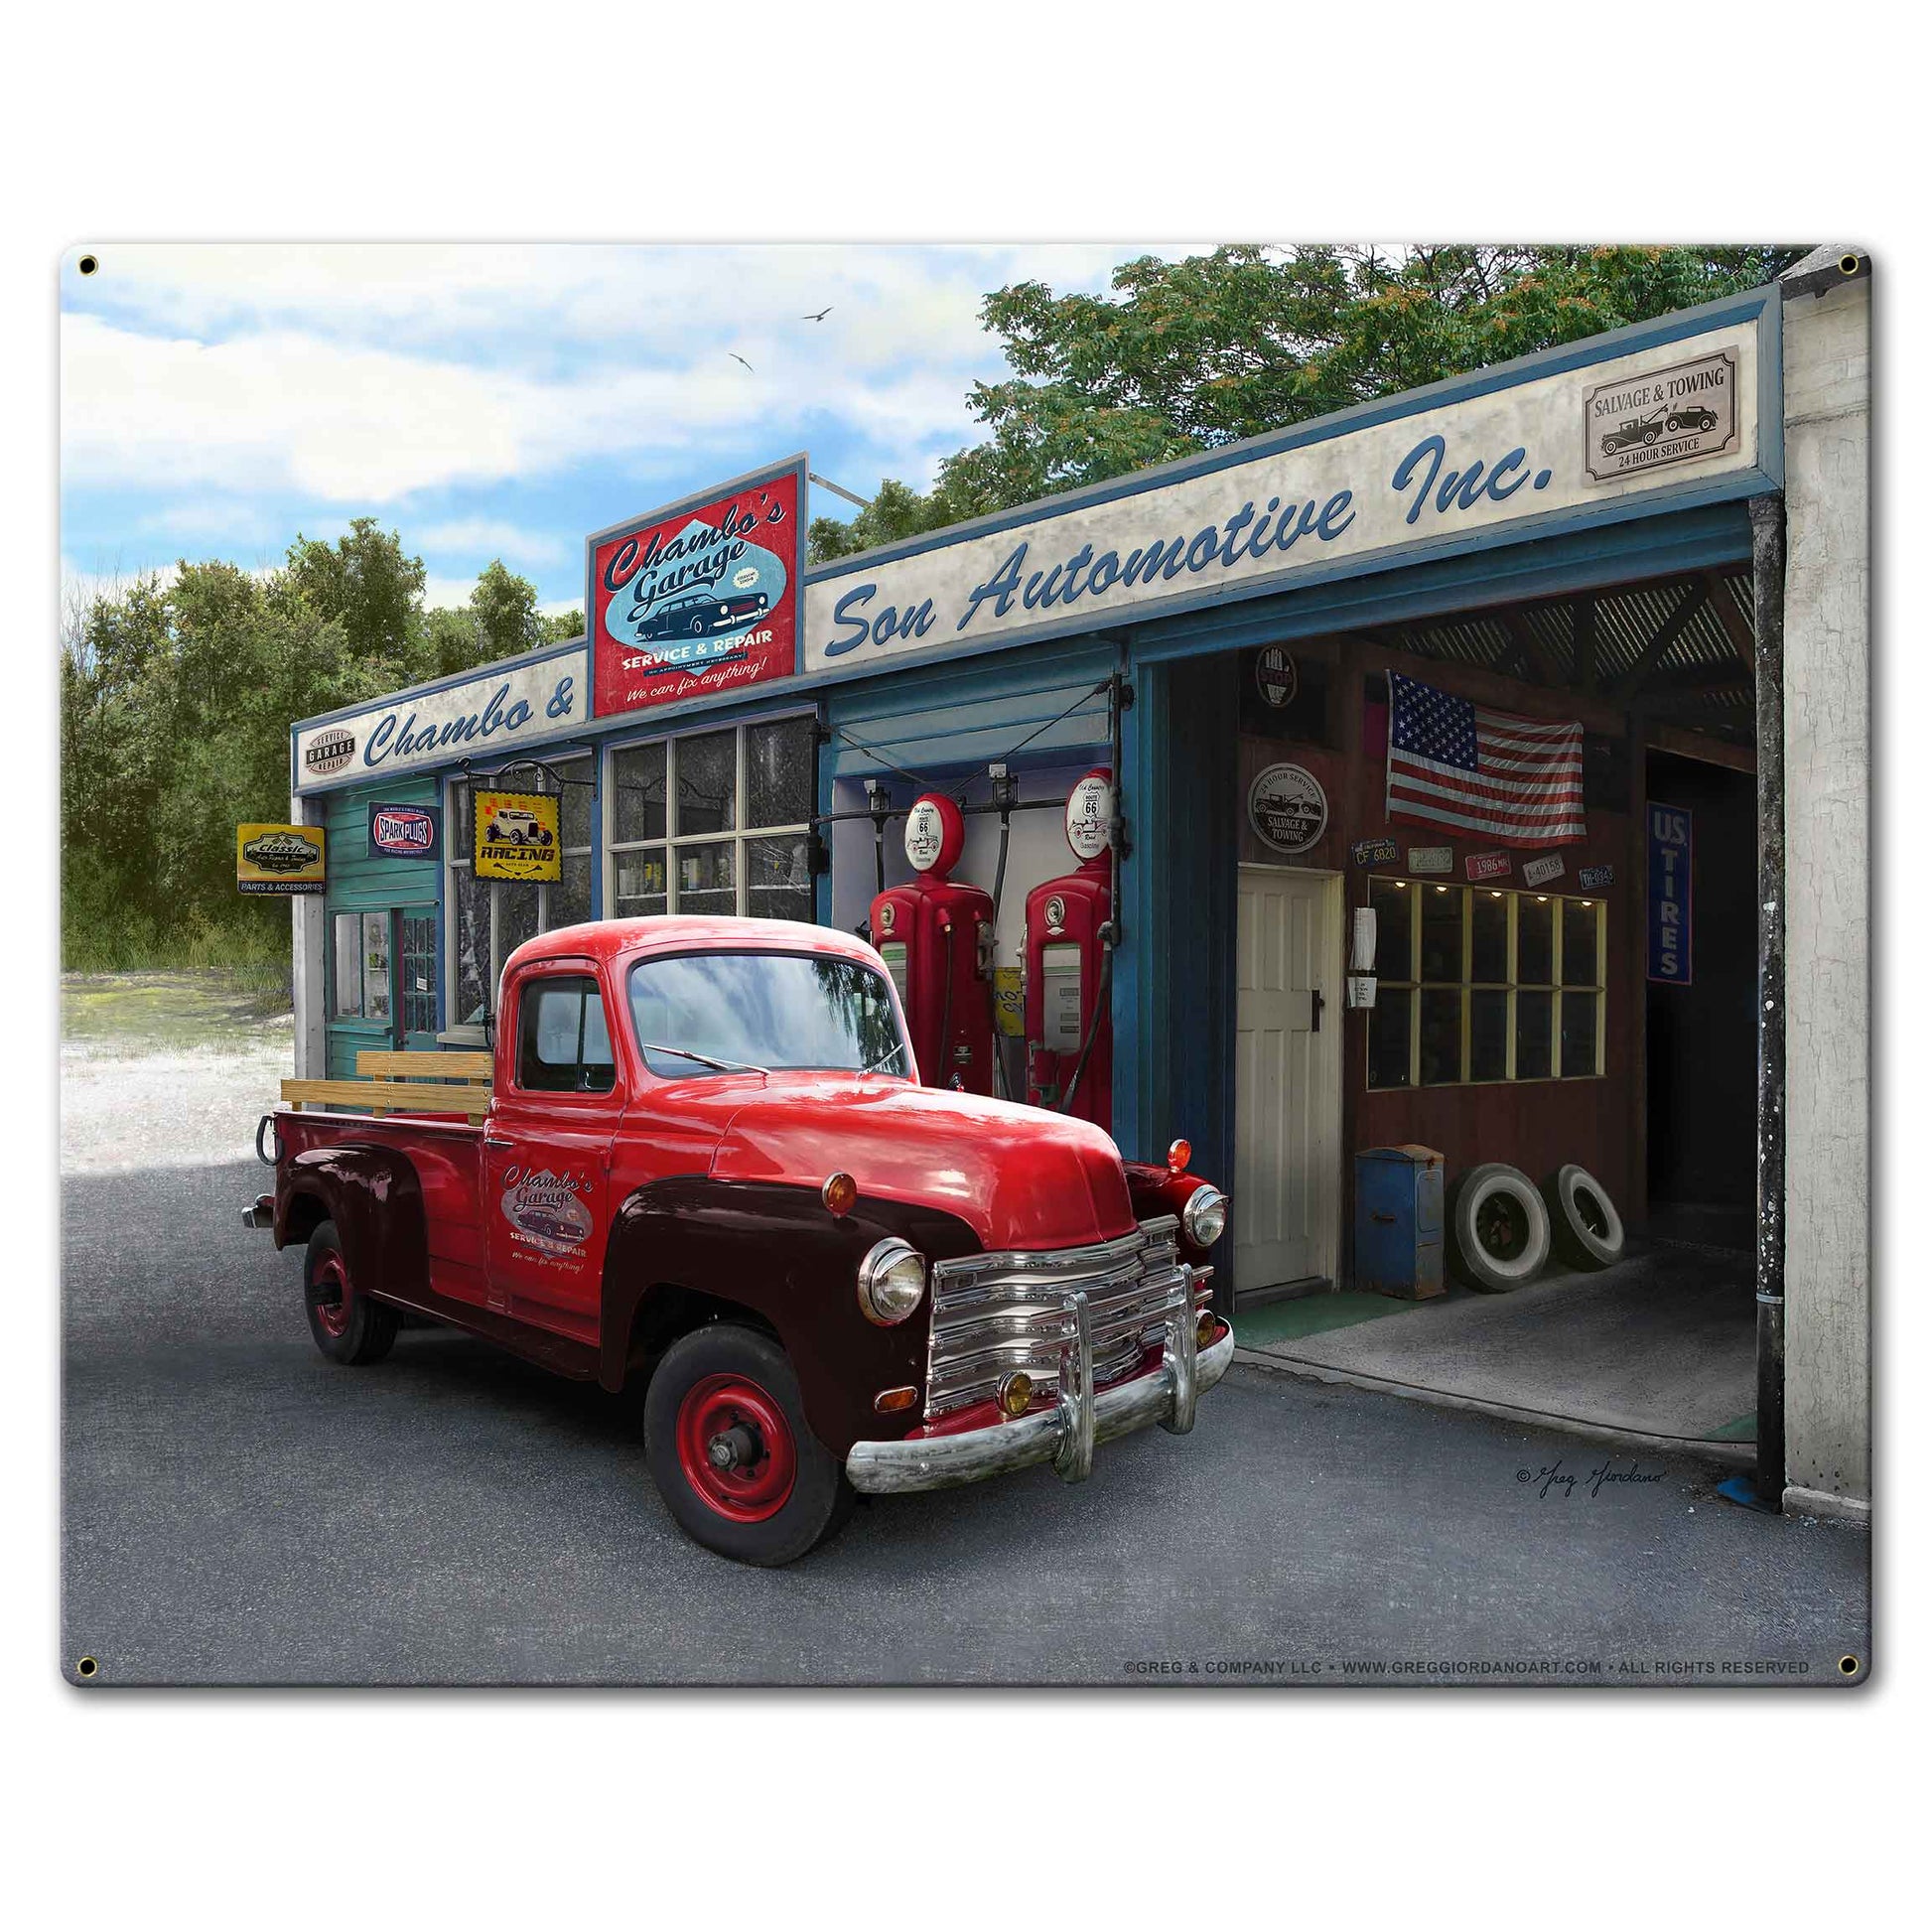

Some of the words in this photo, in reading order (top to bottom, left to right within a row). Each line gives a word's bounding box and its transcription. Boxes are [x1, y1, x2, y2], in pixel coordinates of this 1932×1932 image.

[1594, 387, 1650, 417] SALVAGE
[1652, 383, 1664, 402] &
[1666, 367, 1725, 398] TOWING
[1618, 455, 1630, 468] 24
[1632, 449, 1659, 465] HOUR
[1660, 437, 1700, 458] SERVICE
[604, 492, 786, 593] Chambo's
[823, 582, 937, 657] Son
[956, 487, 1358, 630] Automotive
[1391, 433, 1553, 524] Inc.
[626, 540, 748, 623] Garage
[621, 646, 691, 670] SERVICE
[696, 642, 708, 655] &
[714, 629, 772, 652] REPAIR
[627, 690, 647, 702] We
[650, 683, 675, 696] can
[677, 676, 698, 695] fix
[701, 656, 767, 687] anything!
[363, 682, 534, 767] Chambo
[547, 675, 573, 719] &
[309, 741, 351, 761] GARAGE
[317, 732, 344, 745] SERVICE
[319, 758, 344, 769] REPAIR
[1268, 773, 1288, 786] HOUR
[1290, 773, 1315, 799] SERVICE
[1085, 802, 1097, 813] 66
[380, 817, 404, 842] SPARK
[404, 820, 427, 845] PLUGS
[919, 822, 928, 832] 66
[1268, 816, 1301, 830] SALVAGE
[1301, 820, 1308, 831] &
[1272, 828, 1304, 843] TOWING
[259, 844, 304, 853] Classic
[481, 846, 555, 862] RACING
[1356, 850, 1369, 865] CF
[1374, 846, 1396, 861] 6820
[1476, 858, 1498, 874] 1986
[1660, 848, 1680, 976] TIRES
[500, 1165, 594, 1192] Chambo's
[512, 1187, 574, 1213] Garage
[509, 1231, 546, 1247] SERVICE
[556, 1242, 587, 1258] REPAIR
[1533, 1460, 1578, 1498] Greg
[1586, 1461, 1668, 1498] Giordano
